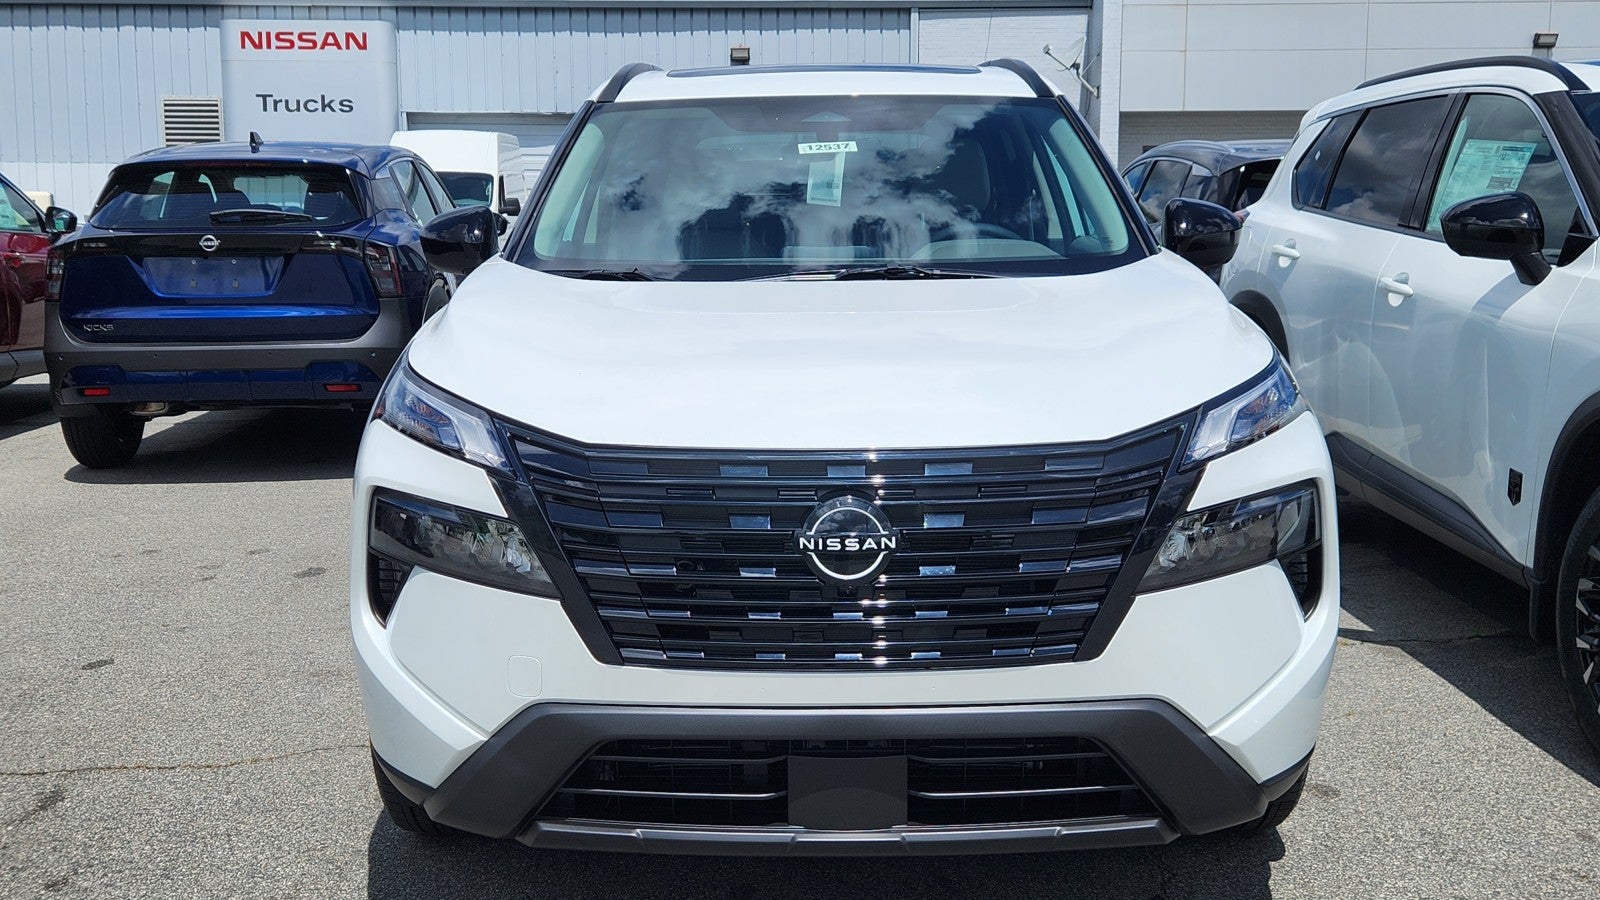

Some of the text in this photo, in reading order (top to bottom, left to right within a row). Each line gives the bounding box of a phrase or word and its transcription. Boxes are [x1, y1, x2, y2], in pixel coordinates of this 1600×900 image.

[239, 30, 368, 51] NISSAN
[255, 93, 354, 113] Trucks
[806, 143, 850, 151] 12537
[83, 324, 114, 332] KICKS
[799, 536, 896, 551] NISSAN
